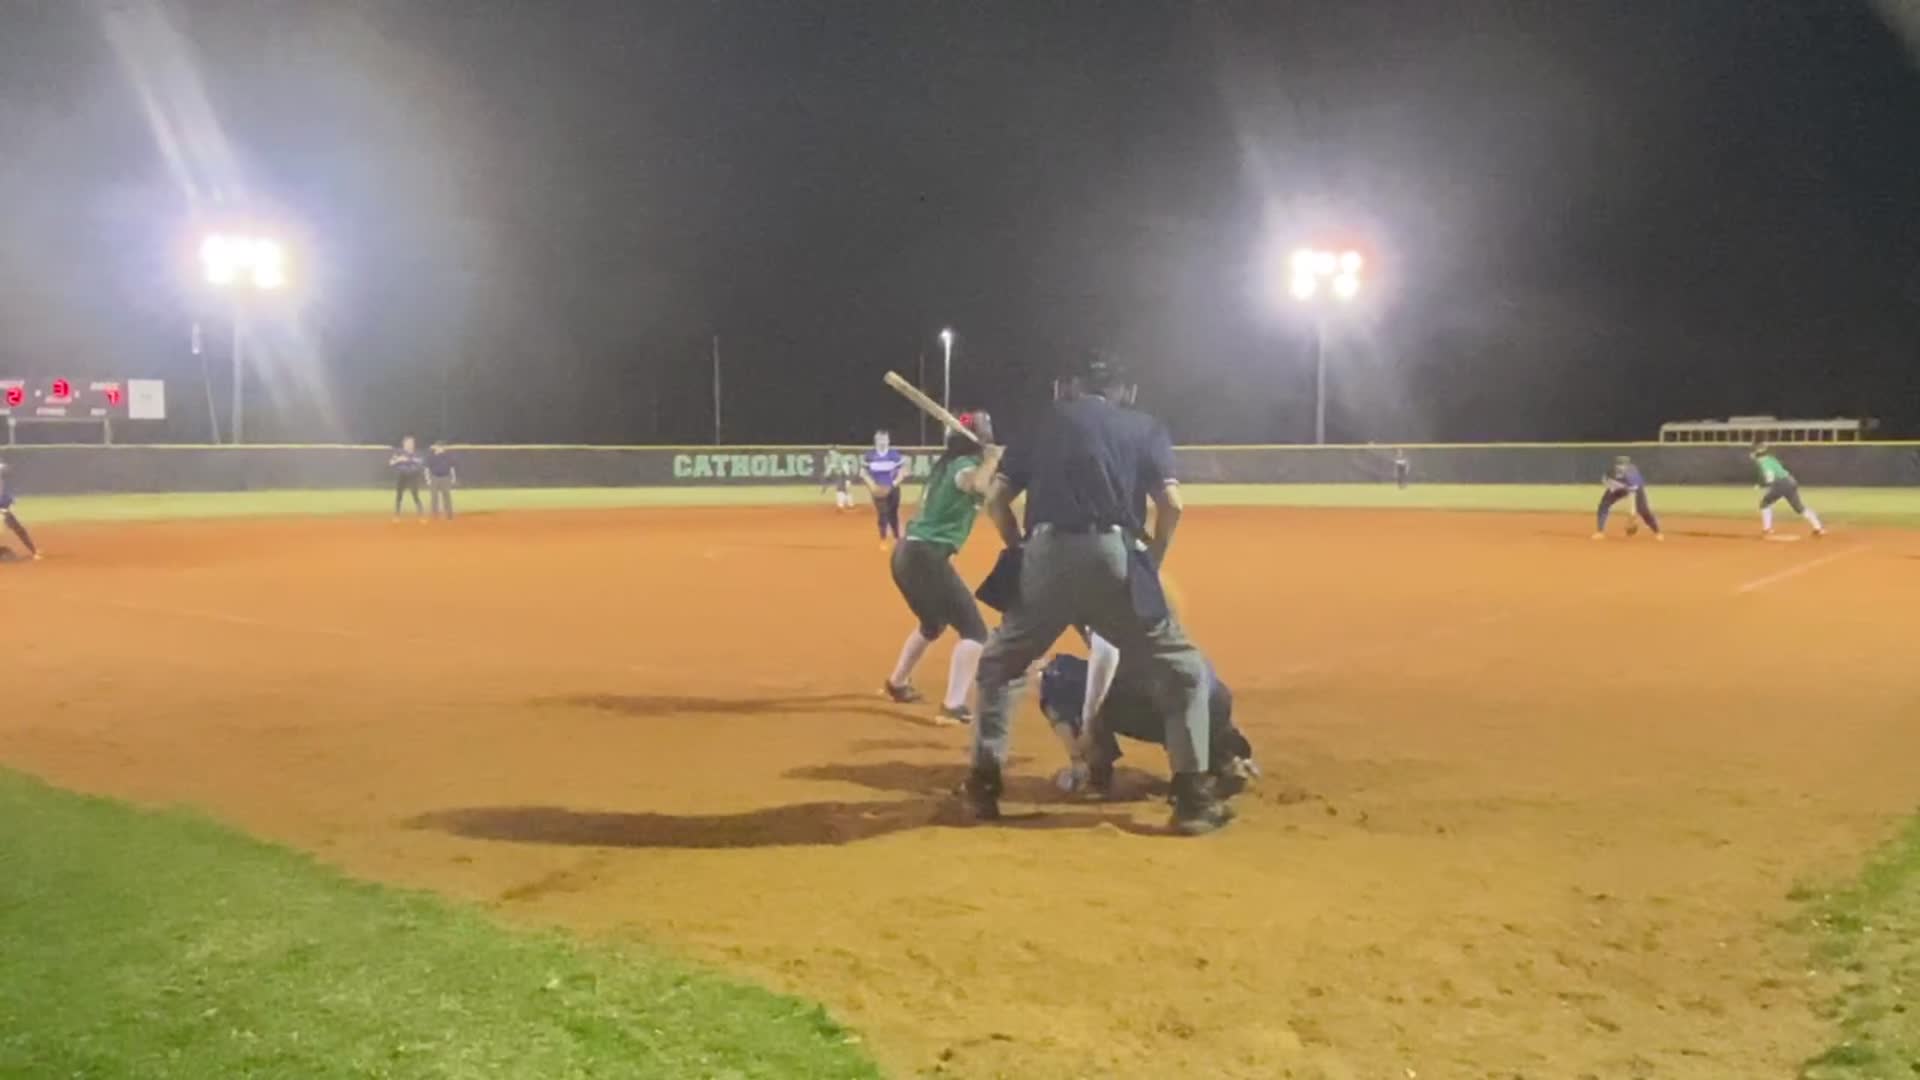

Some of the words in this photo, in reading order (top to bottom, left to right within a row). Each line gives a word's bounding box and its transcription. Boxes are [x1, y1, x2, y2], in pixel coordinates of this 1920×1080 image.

[7, 388, 22, 406] 2
[52, 379, 69, 398] 3
[673, 454, 814, 477] CATHOLIC
